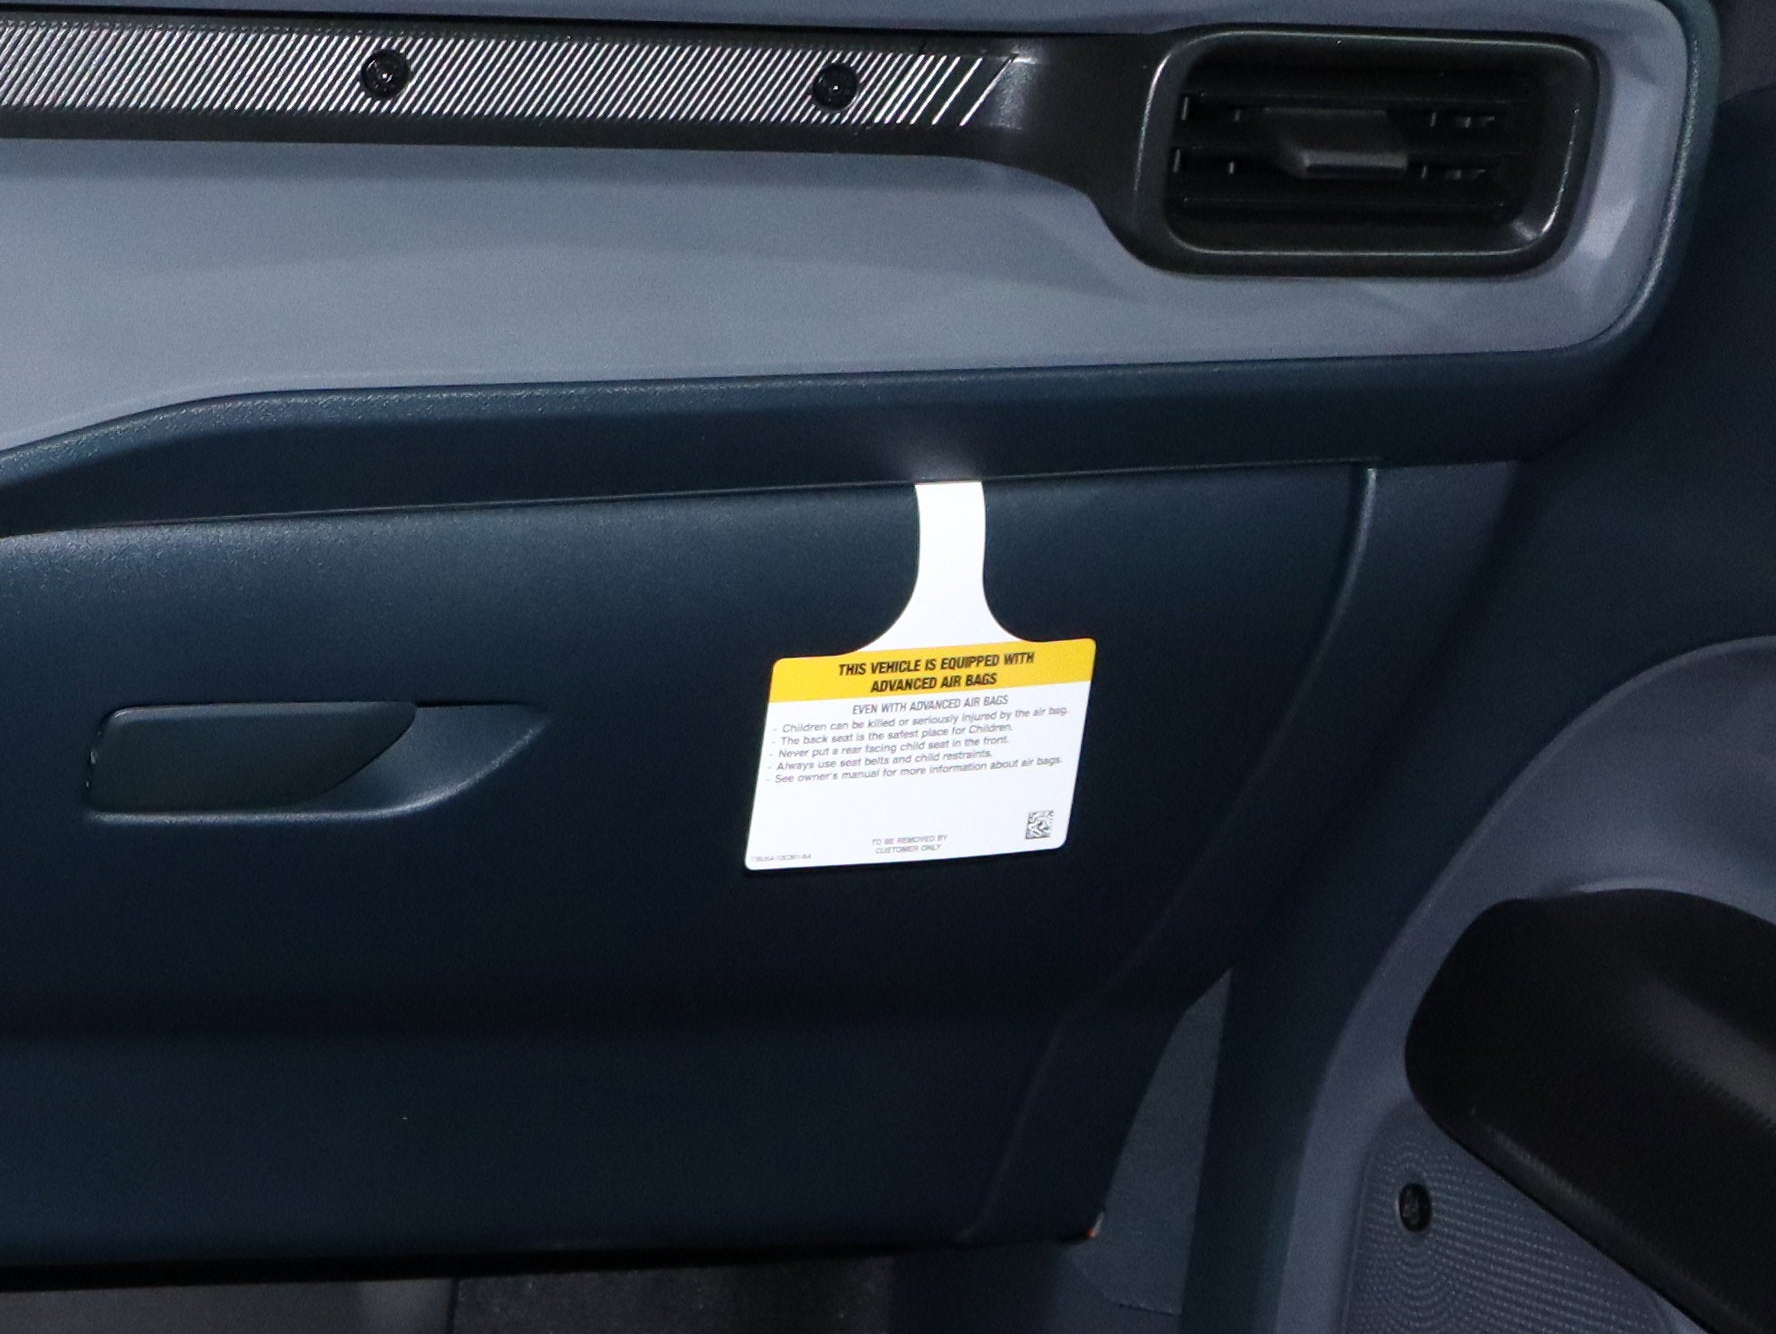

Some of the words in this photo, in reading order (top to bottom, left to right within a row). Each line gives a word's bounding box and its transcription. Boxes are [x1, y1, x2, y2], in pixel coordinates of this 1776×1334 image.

[839, 663, 866, 676] THIS
[870, 660, 921, 675] VEHICLE
[925, 658, 937, 671] IS
[940, 654, 1000, 670] EQUIPPED
[1003, 651, 1035, 665] WITH
[870, 677, 937, 693] ADVANCED
[941, 675, 962, 689] AIR
[965, 672, 998, 686] BAGS
[852, 703, 877, 715] EVEN
[881, 702, 907, 713] WITH
[909, 698, 961, 712] ADVANCED
[963, 696, 981, 708] AIR
[983, 695, 1008, 707] BAGS
[782, 722, 827, 733] Children
[830, 722, 849, 731] can
[852, 720, 865, 729] be
[868, 718, 895, 728] killed
[912, 715, 959, 726] seriously
[962, 711, 997, 723] injured
[999, 711, 1012, 721] by
[1015, 709, 1030, 718] the
[1033, 708, 1046, 717] air
[781, 736, 800, 745] The
[803, 735, 828, 744] back
[832, 734, 853, 743] seat
[856, 733, 865, 742] is
[868, 731, 884, 740] the
[887, 729, 920, 740] safest
[921, 728, 948, 739] place
[951, 726, 966, 736] for
[778, 749, 809, 758] Never
[812, 748, 830, 758] put
[841, 746, 863, 755] rear
[865, 744, 897, 754] facing
[900, 741, 925, 751] child
[928, 740, 949, 749] seat
[952, 738, 961, 747] in
[964, 737, 980, 747] the
[775, 774, 794, 784] See
[841, 769, 880, 779] manual
[883, 768, 897, 777] for
[900, 767, 927, 776] more
[929, 762, 987, 774] information
[990, 759, 1018, 770] about
[1021, 757, 1034, 767] air
[776, 761, 814, 772] Always
[818, 760, 837, 768] use
[840, 758, 862, 768] seat
[865, 756, 889, 766] belts
[892, 755, 912, 764] and
[915, 752, 939, 762] child
